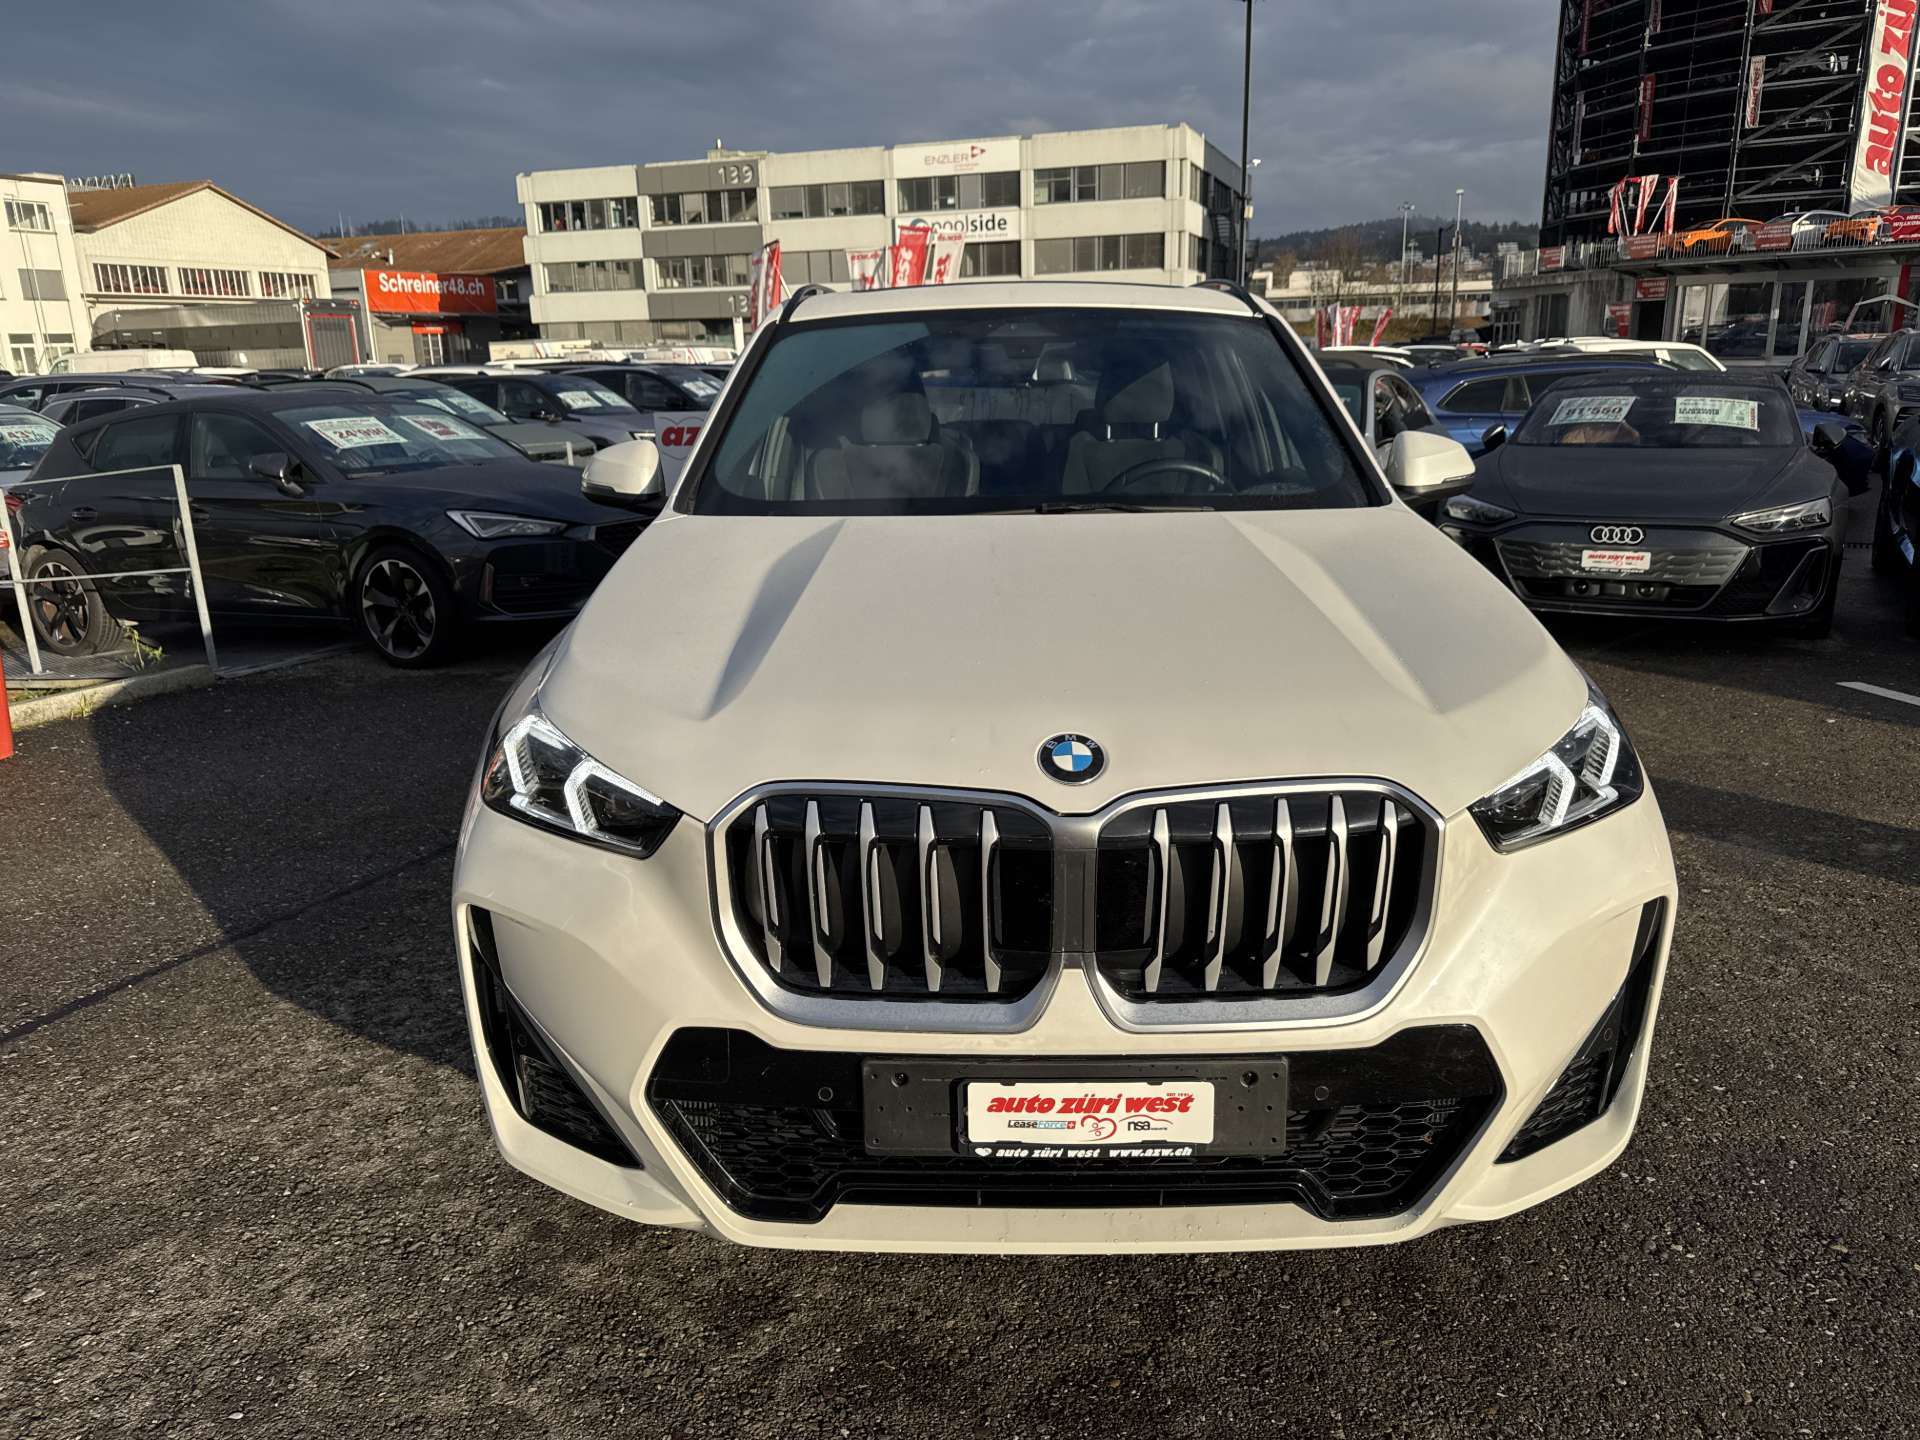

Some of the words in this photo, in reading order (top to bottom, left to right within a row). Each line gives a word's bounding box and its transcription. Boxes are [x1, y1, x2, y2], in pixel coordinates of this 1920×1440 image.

[1866, 64, 1905, 176] auto
[924, 153, 969, 166] ENZLER
[718, 165, 753, 184] 139
[379, 272, 485, 295] Schreiner48.ch
[1045, 734, 1098, 749] BMW
[986, 1094, 1056, 1114] auto
[1056, 1093, 1123, 1114] züri
[1125, 1096, 1195, 1114] west
[1127, 1120, 1151, 1131] nsa
[996, 1148, 1028, 1158] auto
[1031, 1147, 1063, 1158] züri
[1067, 1147, 1101, 1158] west
[1108, 1146, 1192, 1158] www.azw.ch
